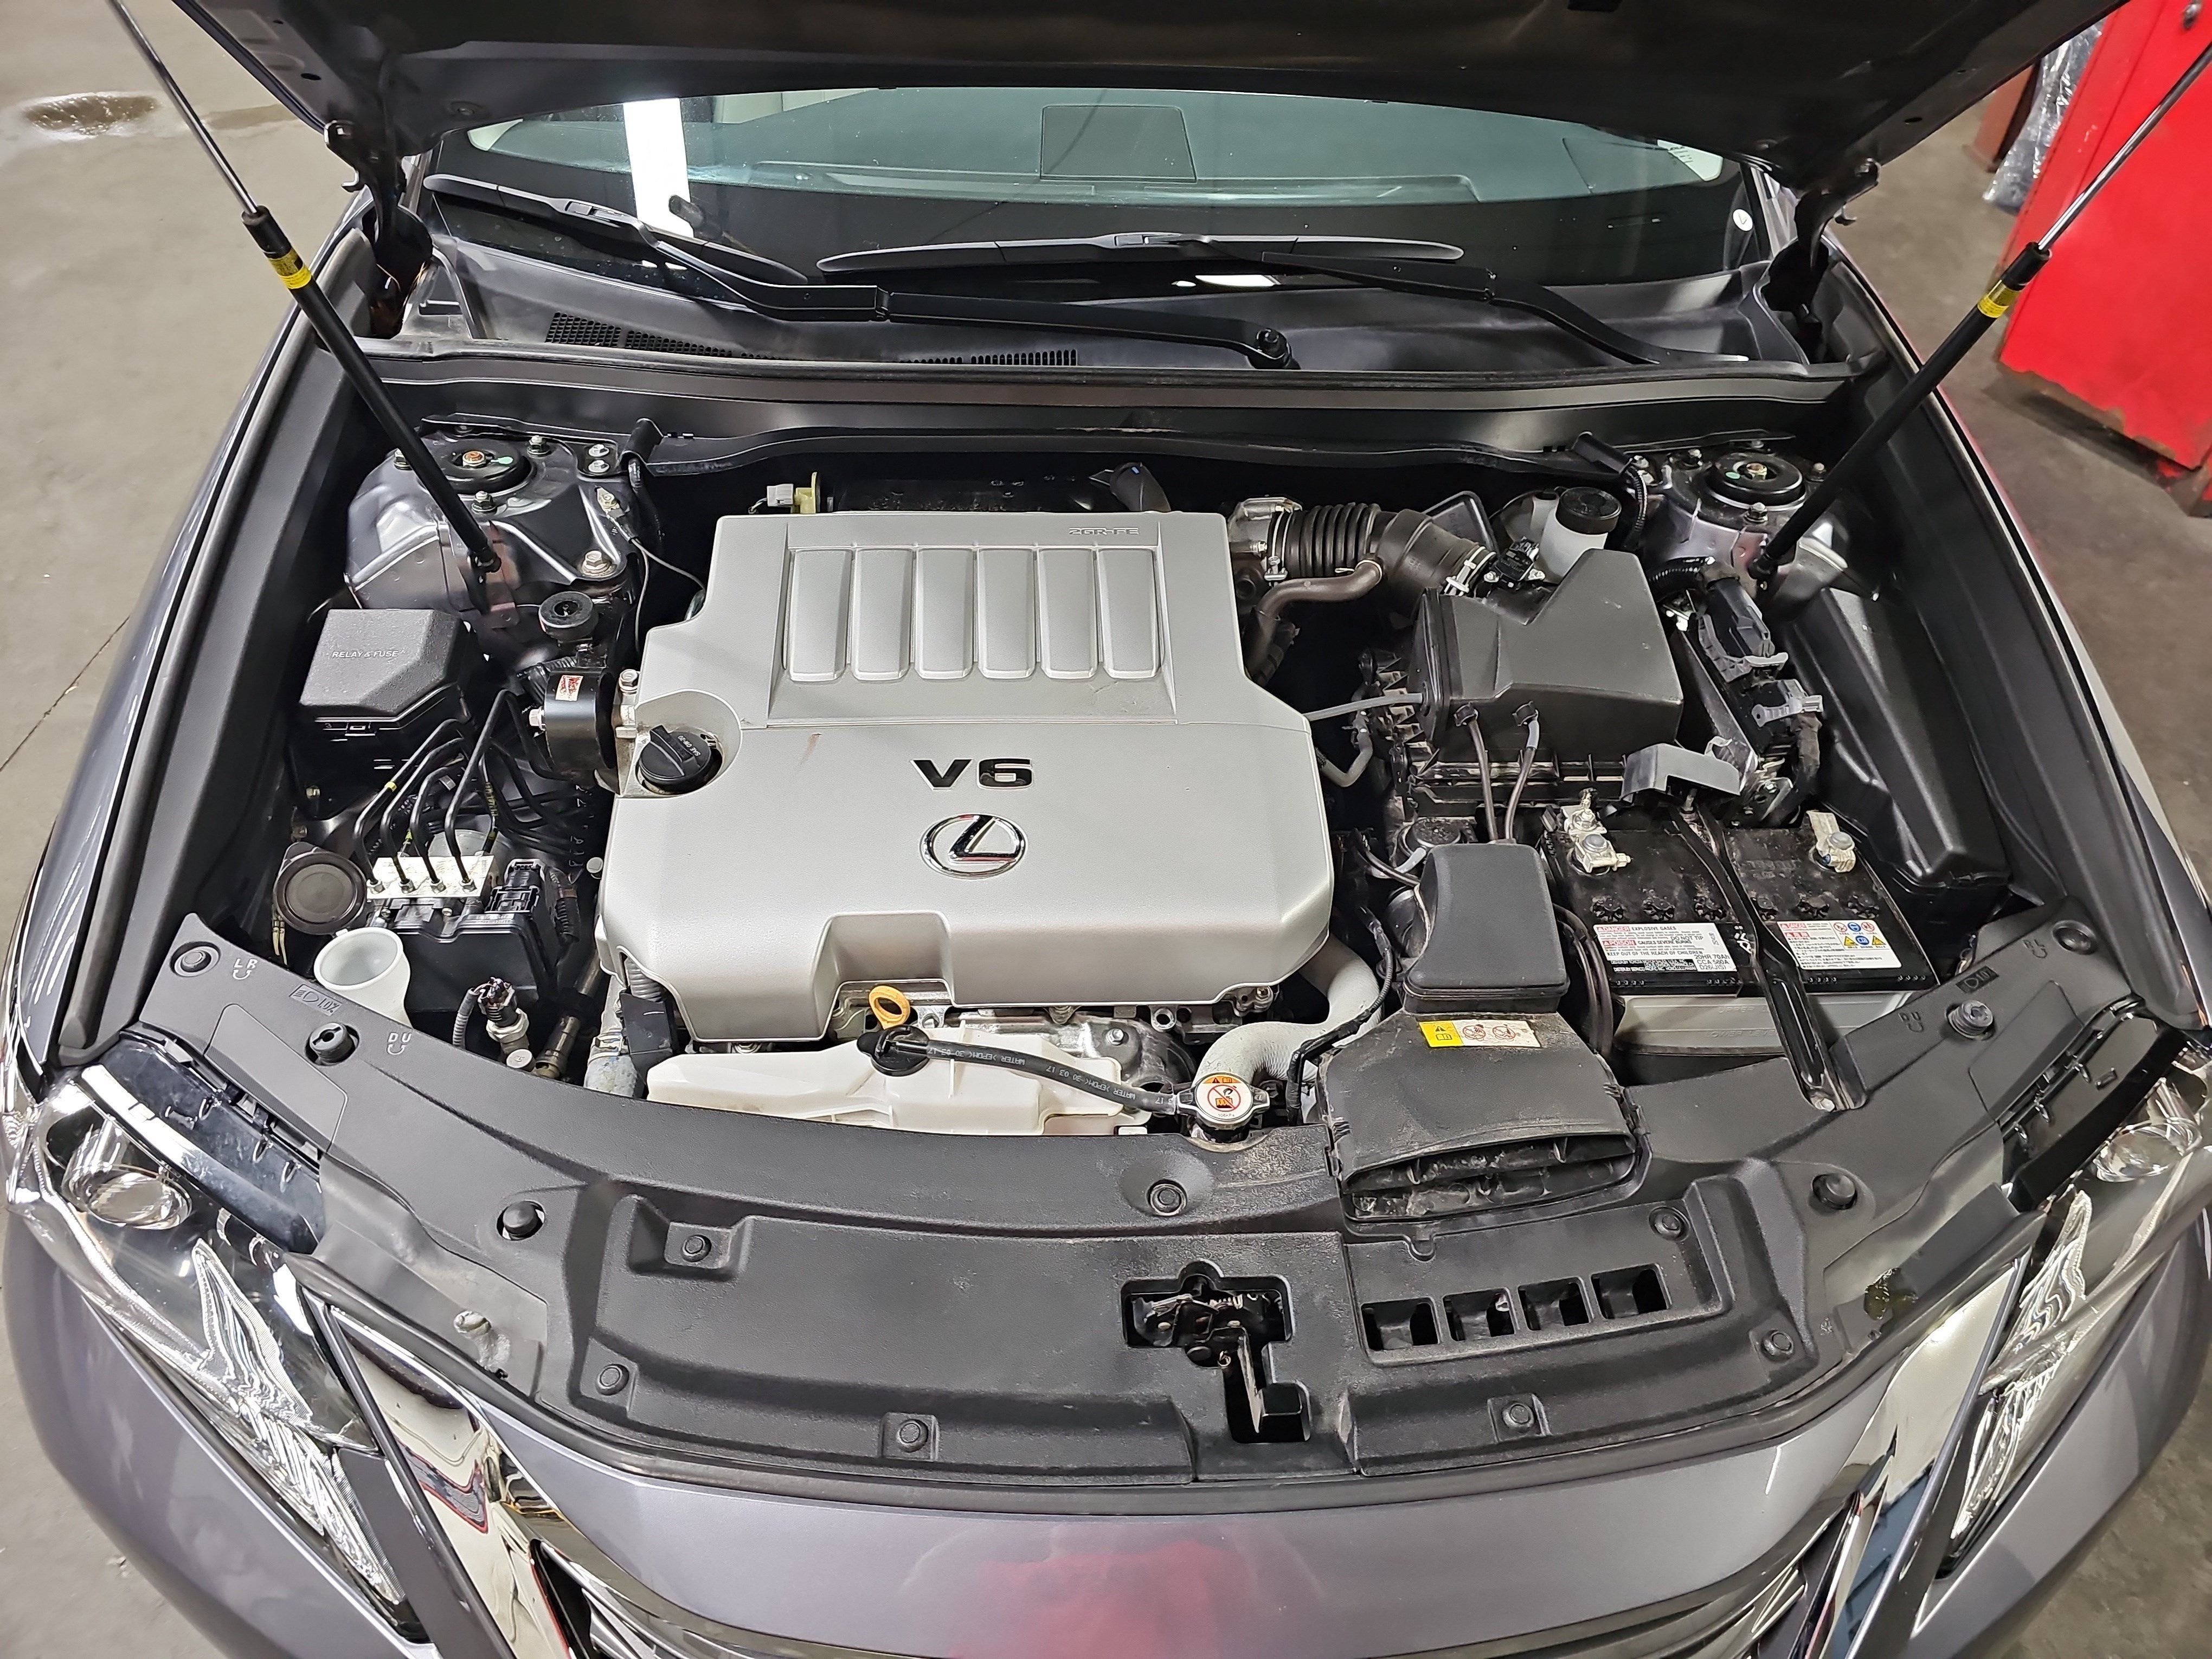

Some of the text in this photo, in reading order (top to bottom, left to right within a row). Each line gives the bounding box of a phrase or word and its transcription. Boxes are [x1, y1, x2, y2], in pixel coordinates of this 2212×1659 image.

[678, 735, 701, 756] SAE 0W-20
[910, 757, 1033, 790] V6
[234, 958, 258, 969] L R
[317, 997, 343, 1013] 1.0%
[388, 1032, 412, 1042] D U
[1001, 1056, 1025, 1066] WATER
[1059, 1069, 1069, 1077] 03
[1072, 1073, 1083, 1082] 30
[1113, 1088, 1136, 1099] WATER
